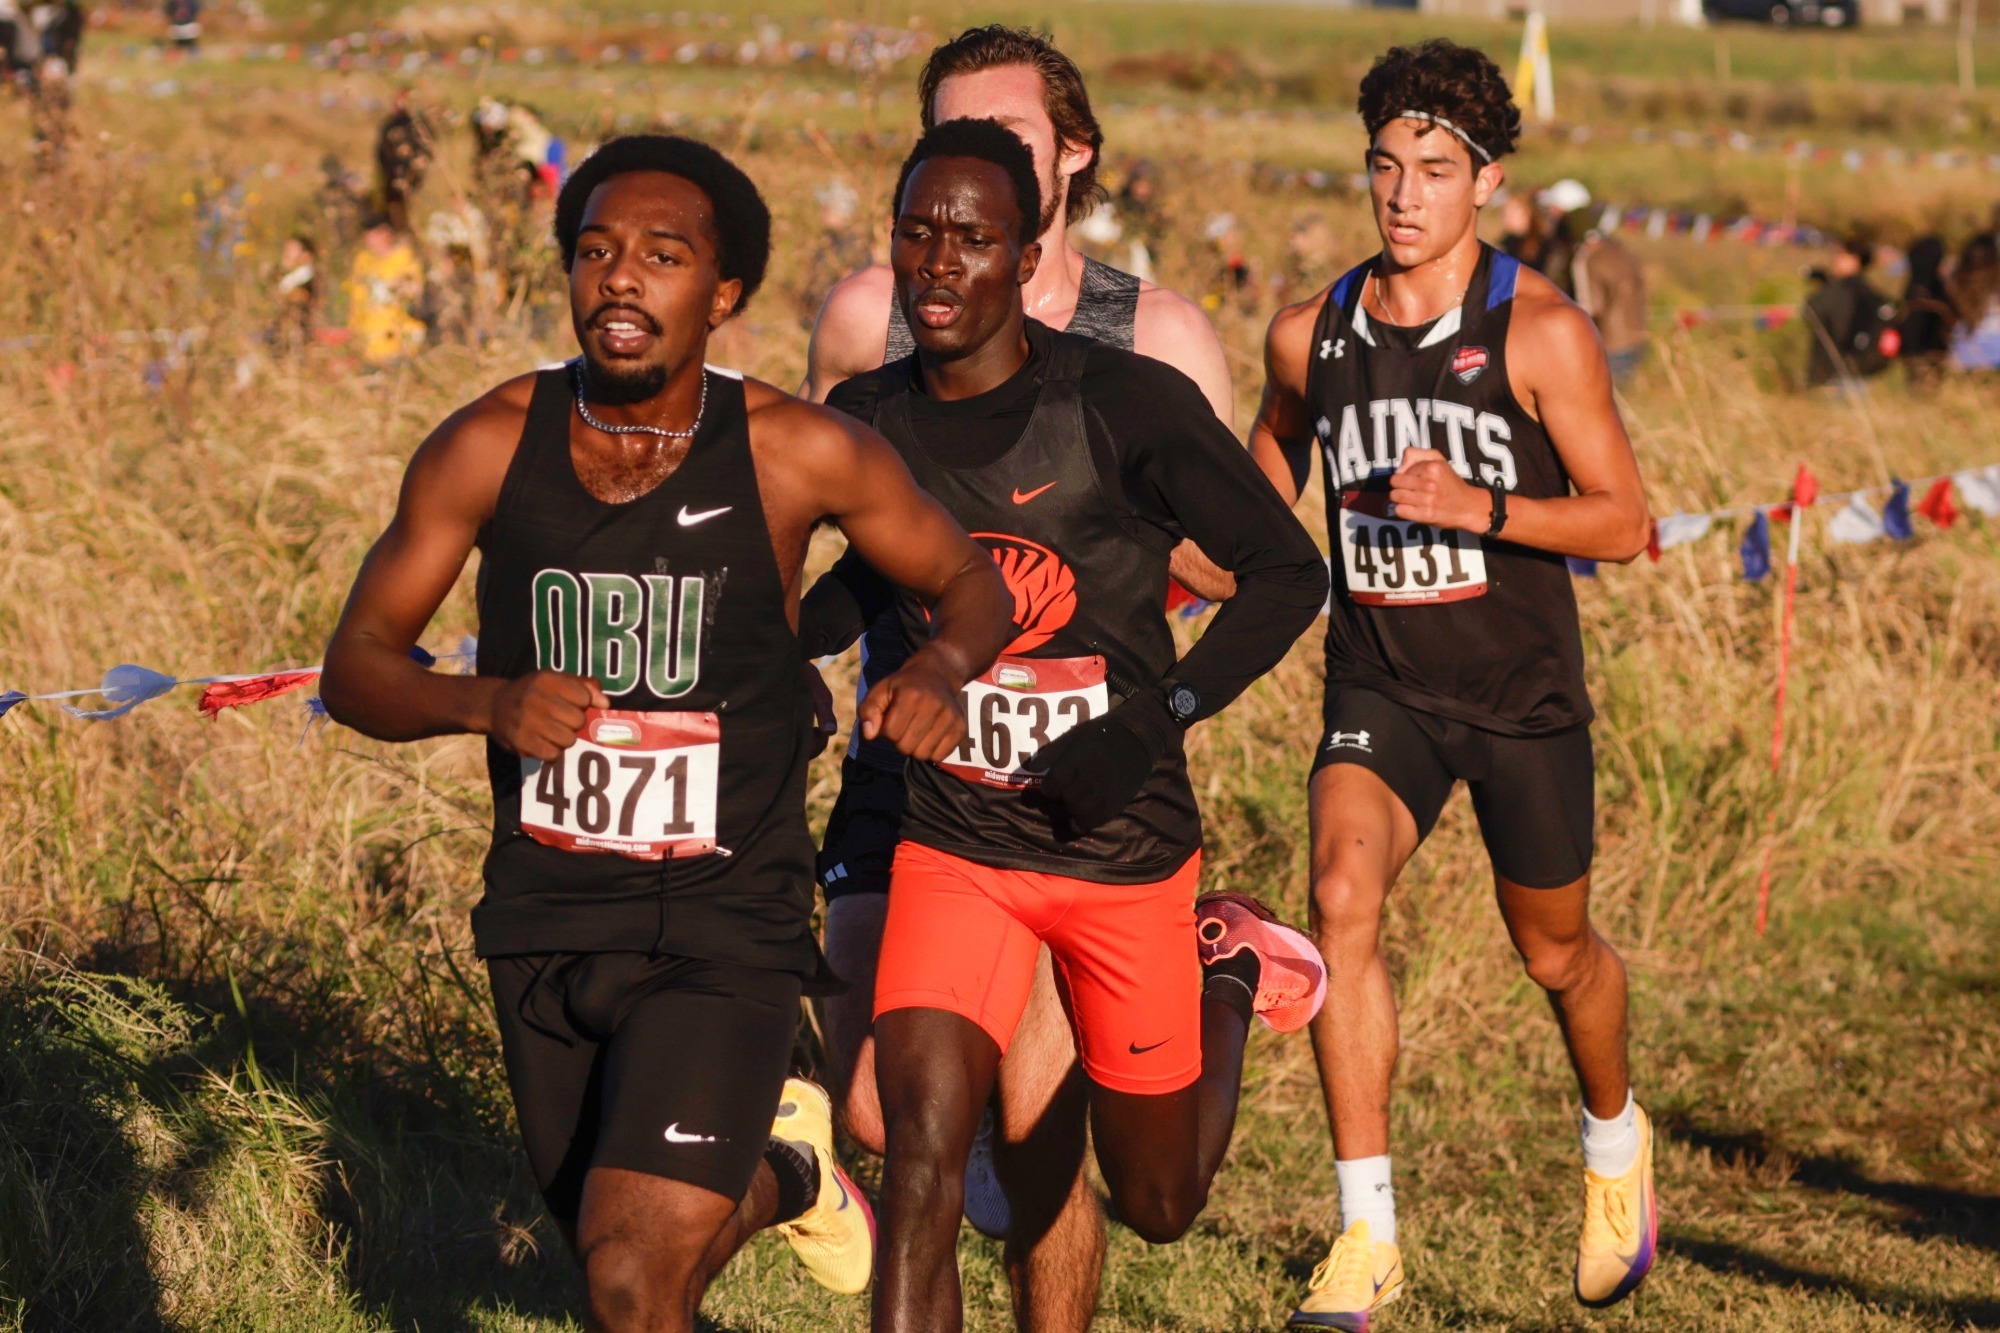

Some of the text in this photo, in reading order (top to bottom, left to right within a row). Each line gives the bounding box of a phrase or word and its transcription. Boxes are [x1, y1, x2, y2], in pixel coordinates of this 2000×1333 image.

[1354, 523, 1470, 589] 4931
[532, 568, 705, 699] OBU
[535, 751, 695, 837] 4871
[984, 770, 1042, 786] midwesttiming.c
[575, 836, 651, 853] midwesttiming.com
